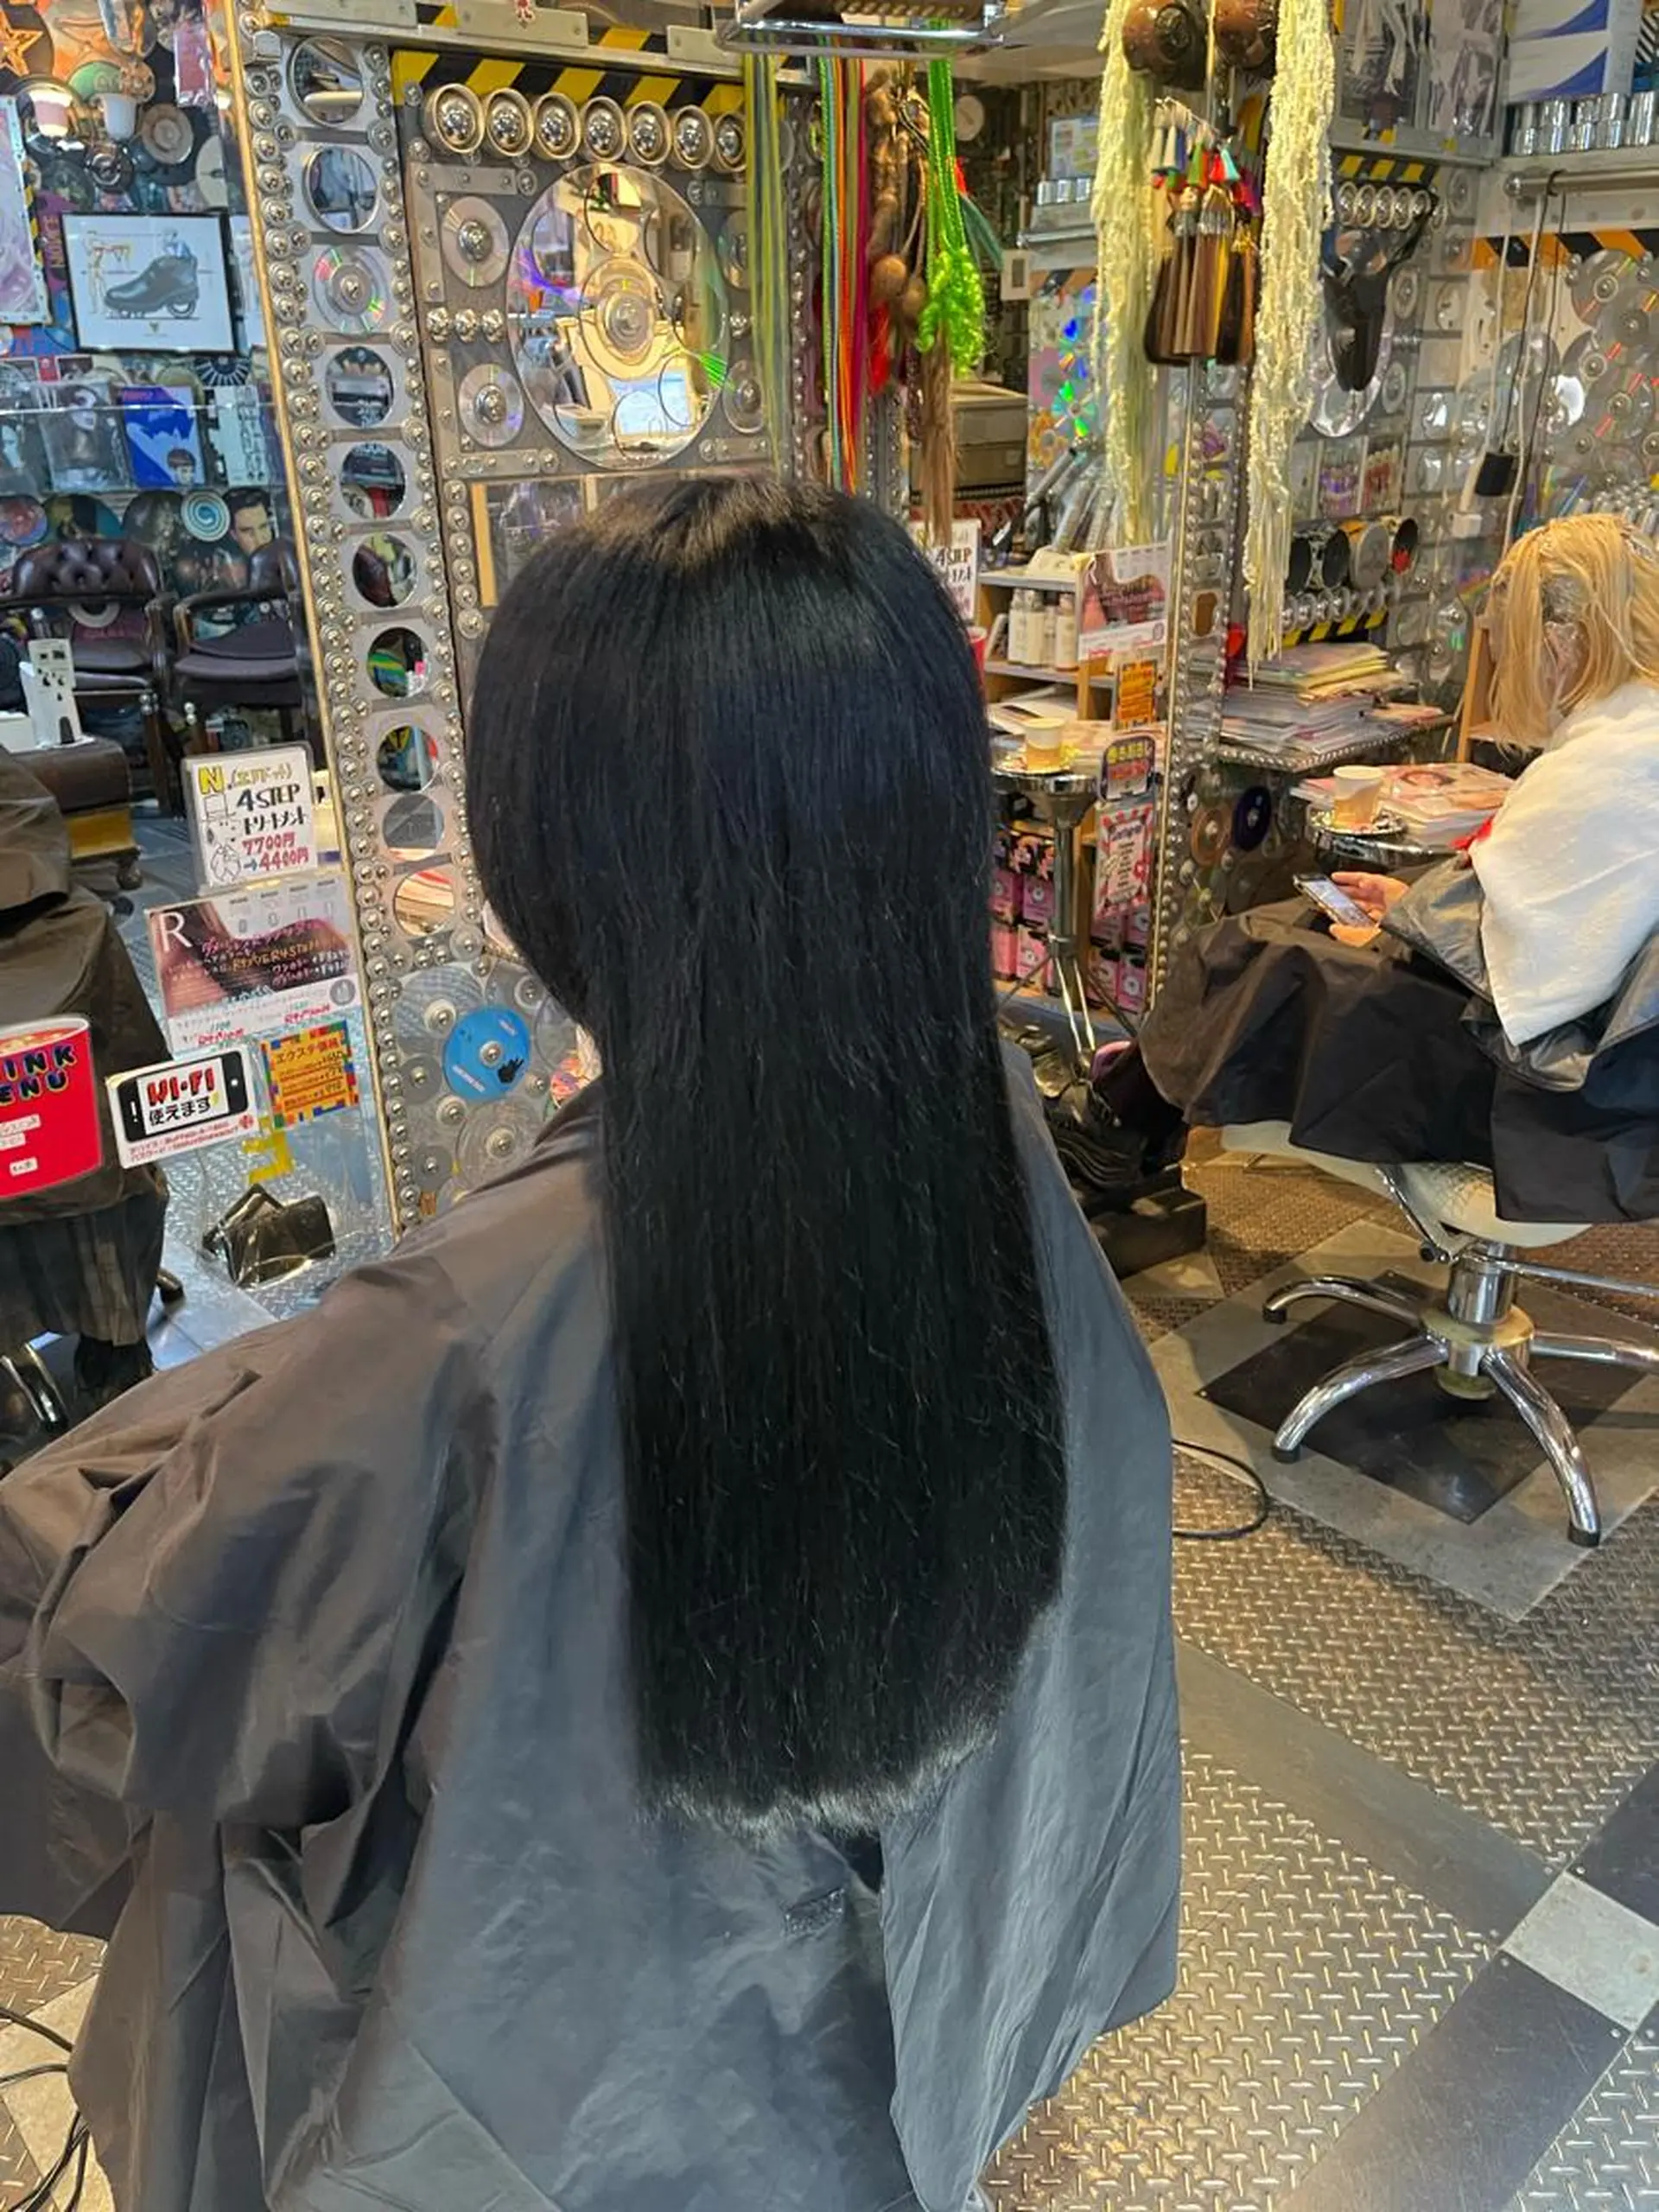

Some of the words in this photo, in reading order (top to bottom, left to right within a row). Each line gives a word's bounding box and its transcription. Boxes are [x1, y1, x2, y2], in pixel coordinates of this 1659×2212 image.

[160, 912, 192, 951] R
[149, 1096, 212, 1127] 使えます
